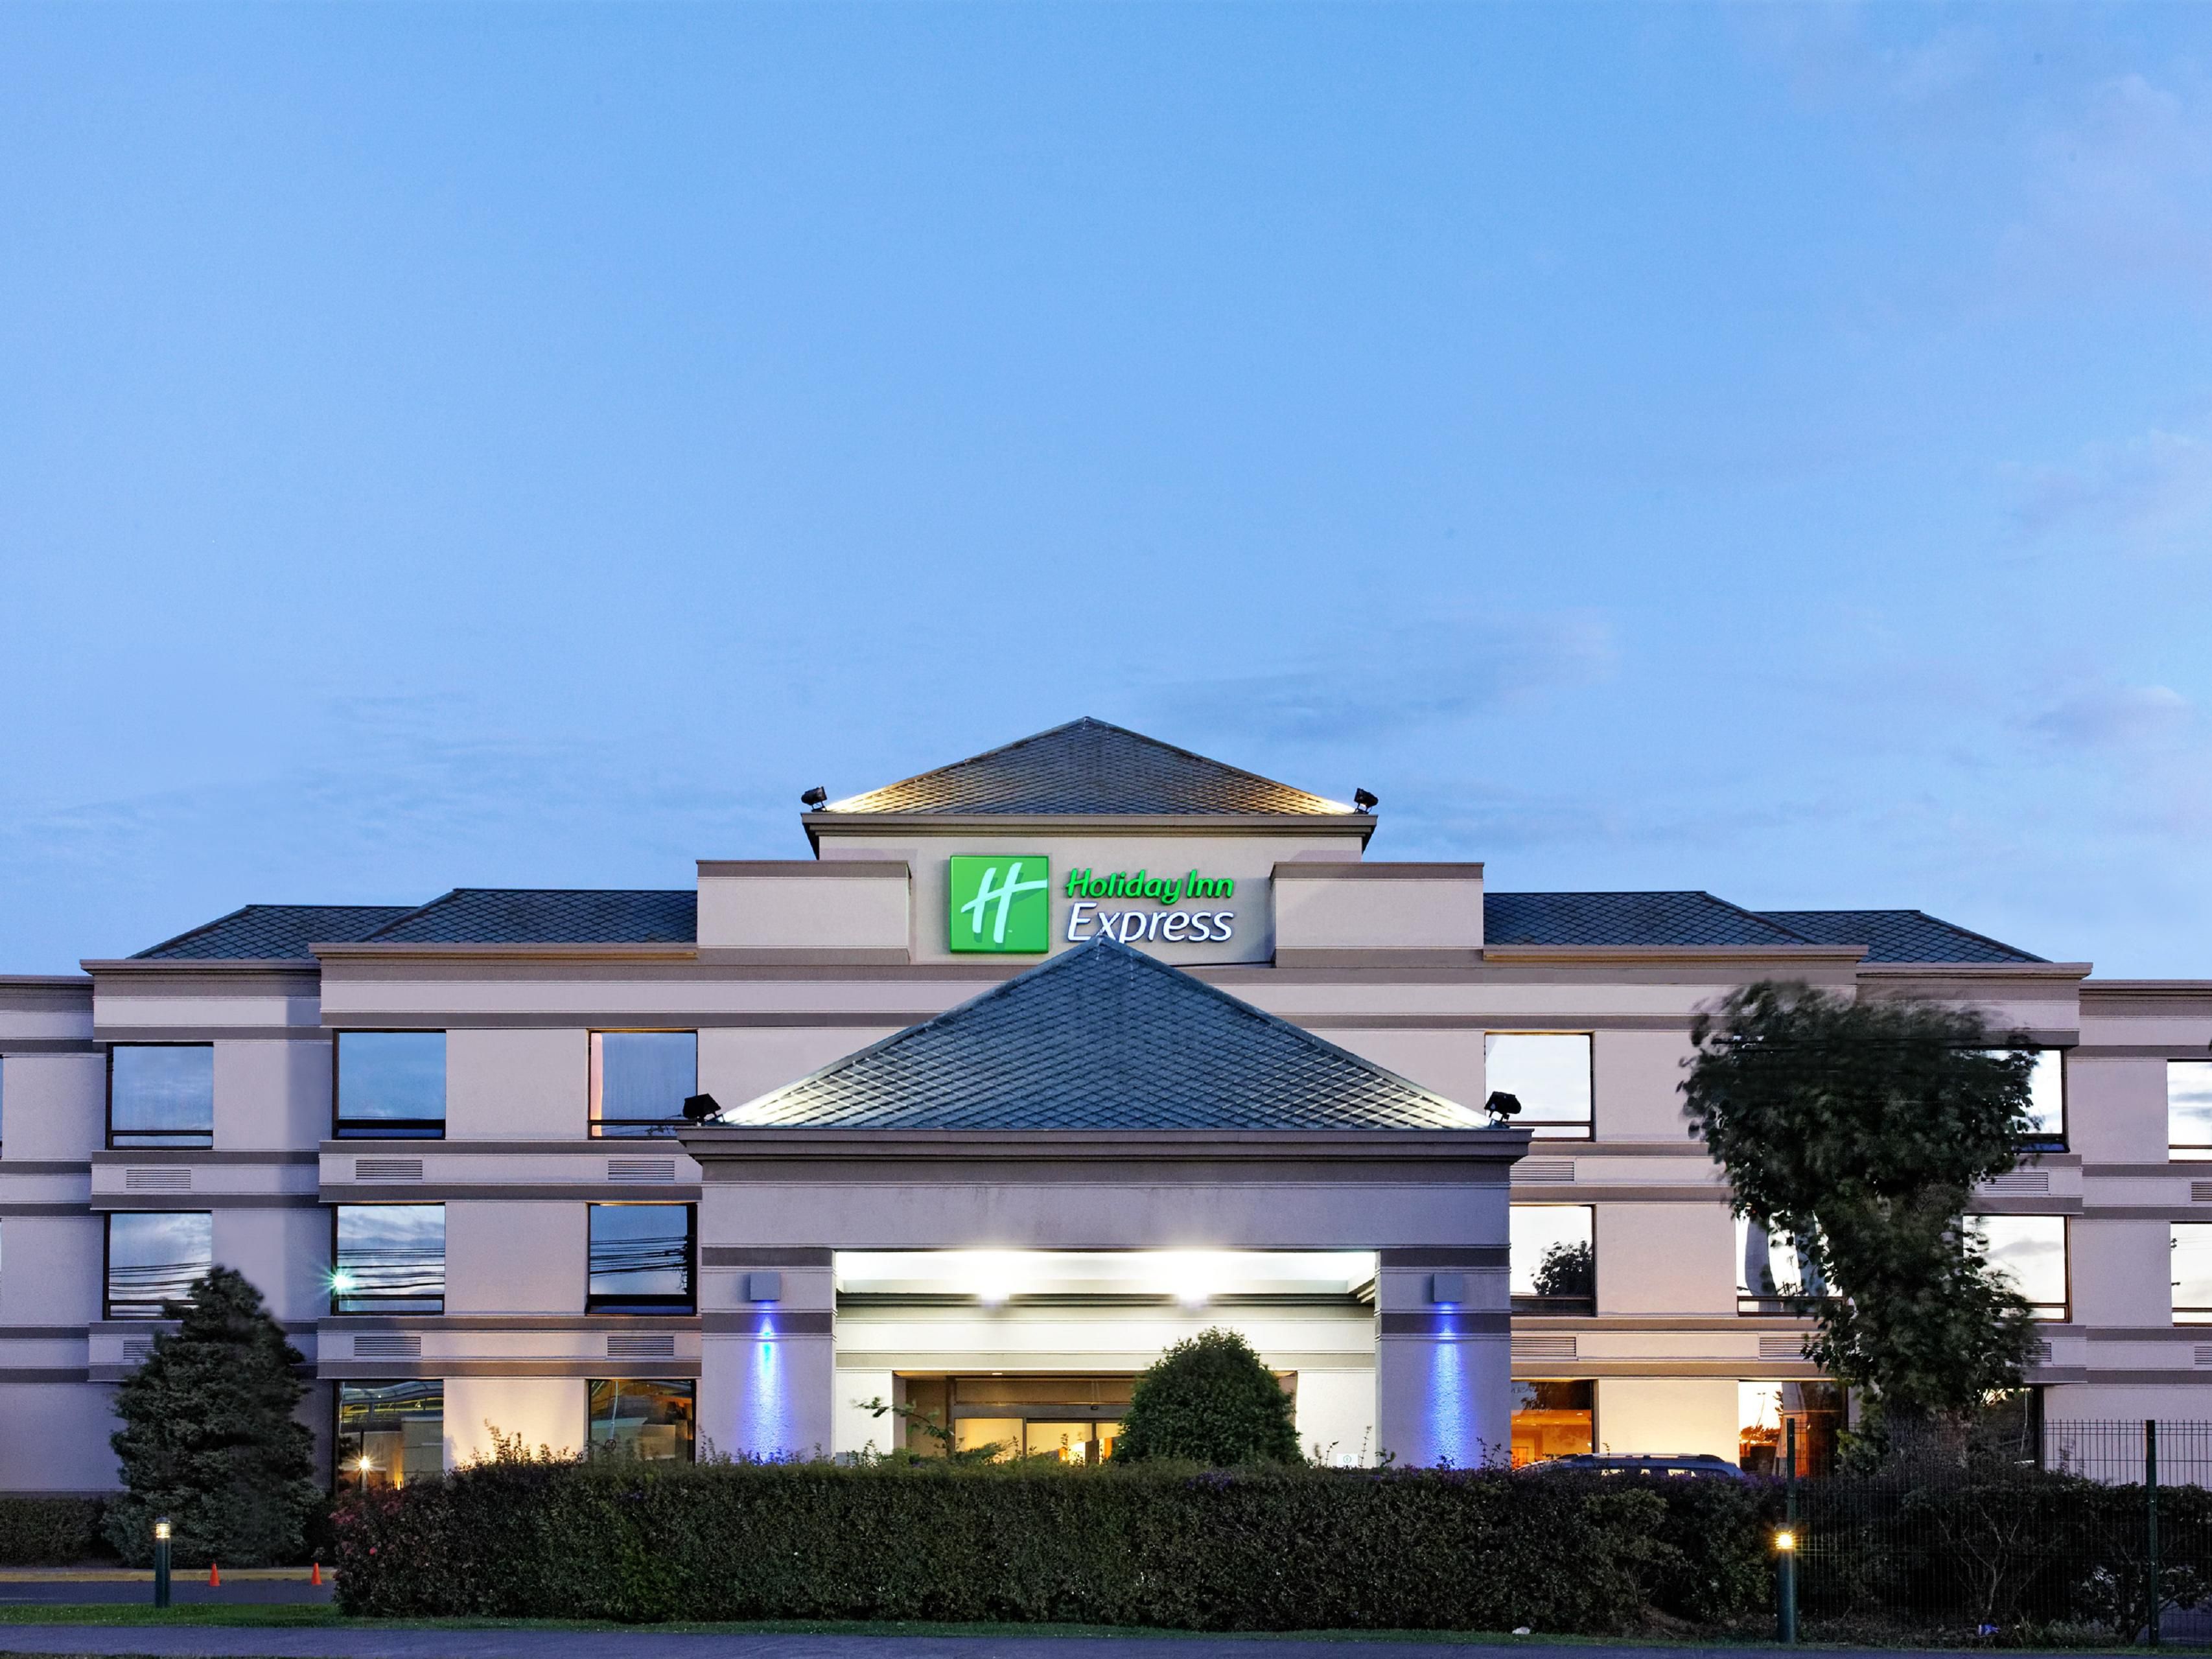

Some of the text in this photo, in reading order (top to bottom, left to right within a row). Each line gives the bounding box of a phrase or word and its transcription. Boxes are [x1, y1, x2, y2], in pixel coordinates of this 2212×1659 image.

[960, 862, 1047, 943] H
[1065, 868, 1235, 905] Holiday Inn
[1067, 901, 1234, 944] Express
